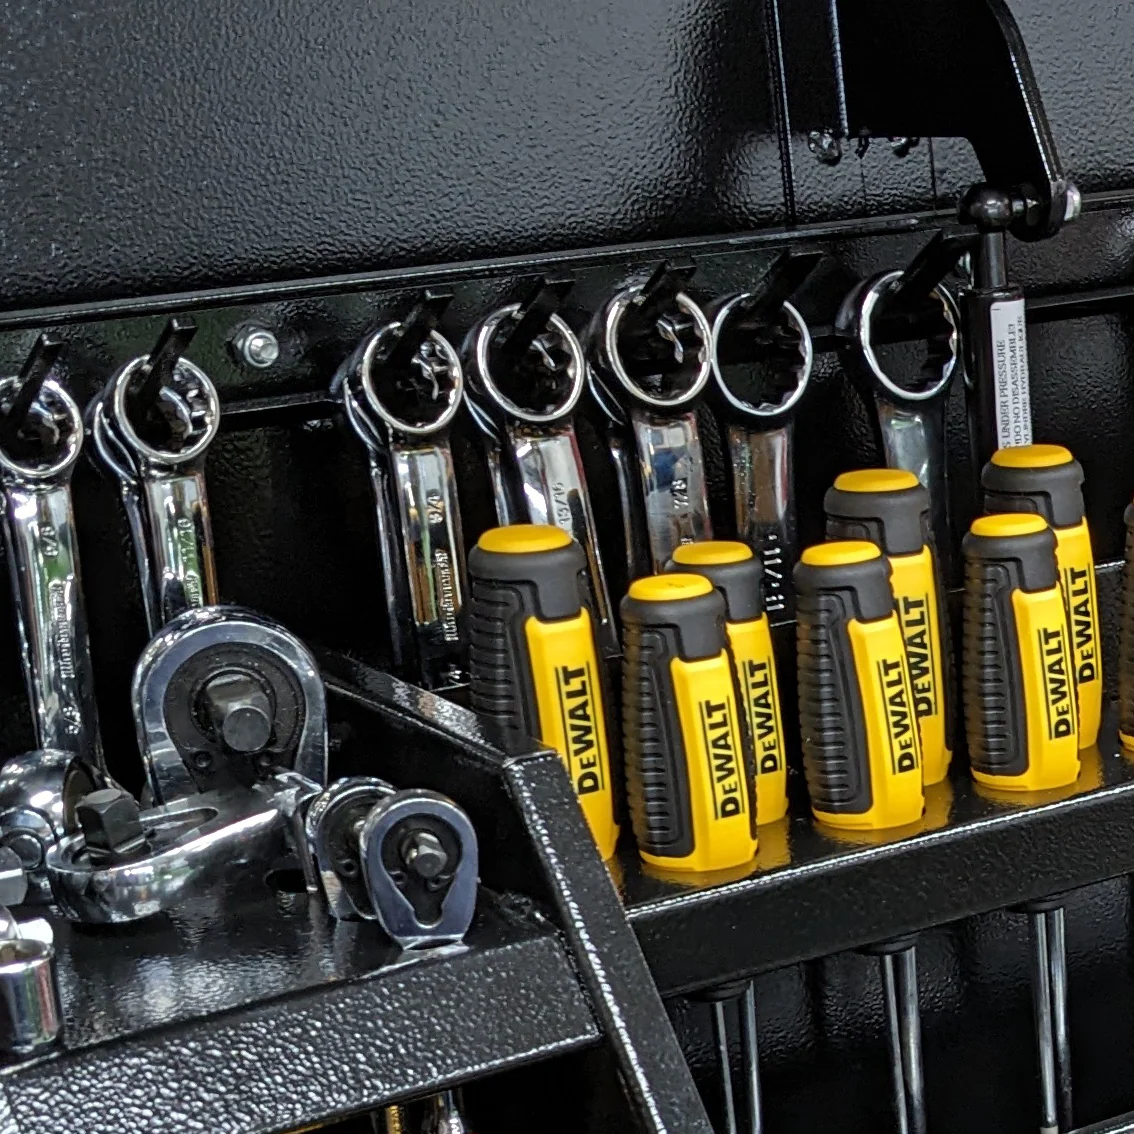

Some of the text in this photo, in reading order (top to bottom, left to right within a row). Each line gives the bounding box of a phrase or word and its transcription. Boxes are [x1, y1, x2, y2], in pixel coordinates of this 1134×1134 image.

[996, 339, 1009, 398] PRESSURE
[999, 400, 1011, 438] UNDER
[907, 596, 934, 717] DEWALT
[1044, 627, 1073, 739] DEWALT
[1069, 567, 1095, 684] DEWALT
[564, 664, 602, 795] DEWALT
[706, 700, 741, 819] DEWALT
[749, 660, 779, 774] DEWALT
[884, 659, 918, 774] DEWALT
